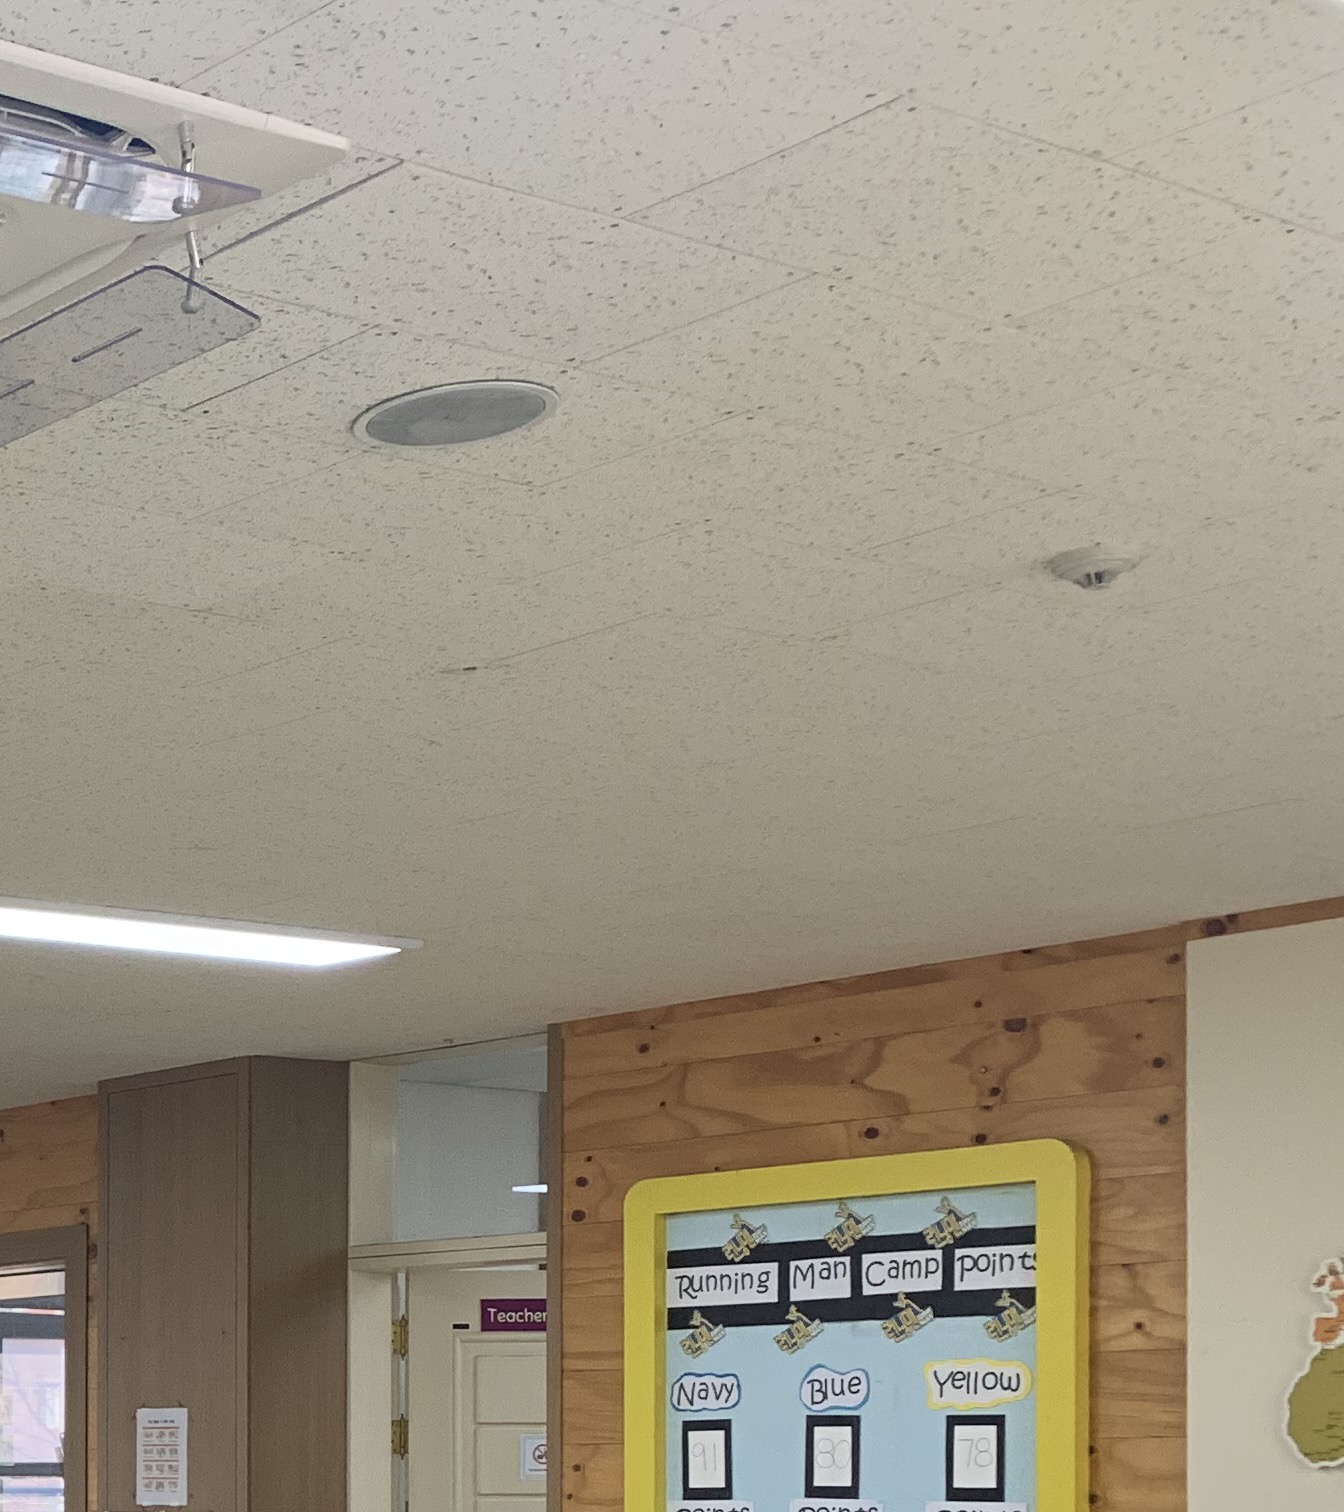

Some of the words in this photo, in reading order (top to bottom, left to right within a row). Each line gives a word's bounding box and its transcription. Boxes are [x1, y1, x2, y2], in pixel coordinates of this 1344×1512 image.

[675, 1270, 772, 1300] Running
[793, 1261, 847, 1290] Man
[865, 1252, 941, 1288] Camp
[486, 1307, 547, 1323] Teacher
[676, 1382, 735, 1408] Navy
[809, 1376, 862, 1405] Blue
[933, 1366, 1021, 1394] Yellow
[691, 1440, 720, 1472] 91
[814, 1437, 850, 1470] 80
[958, 1436, 994, 1469] 78
